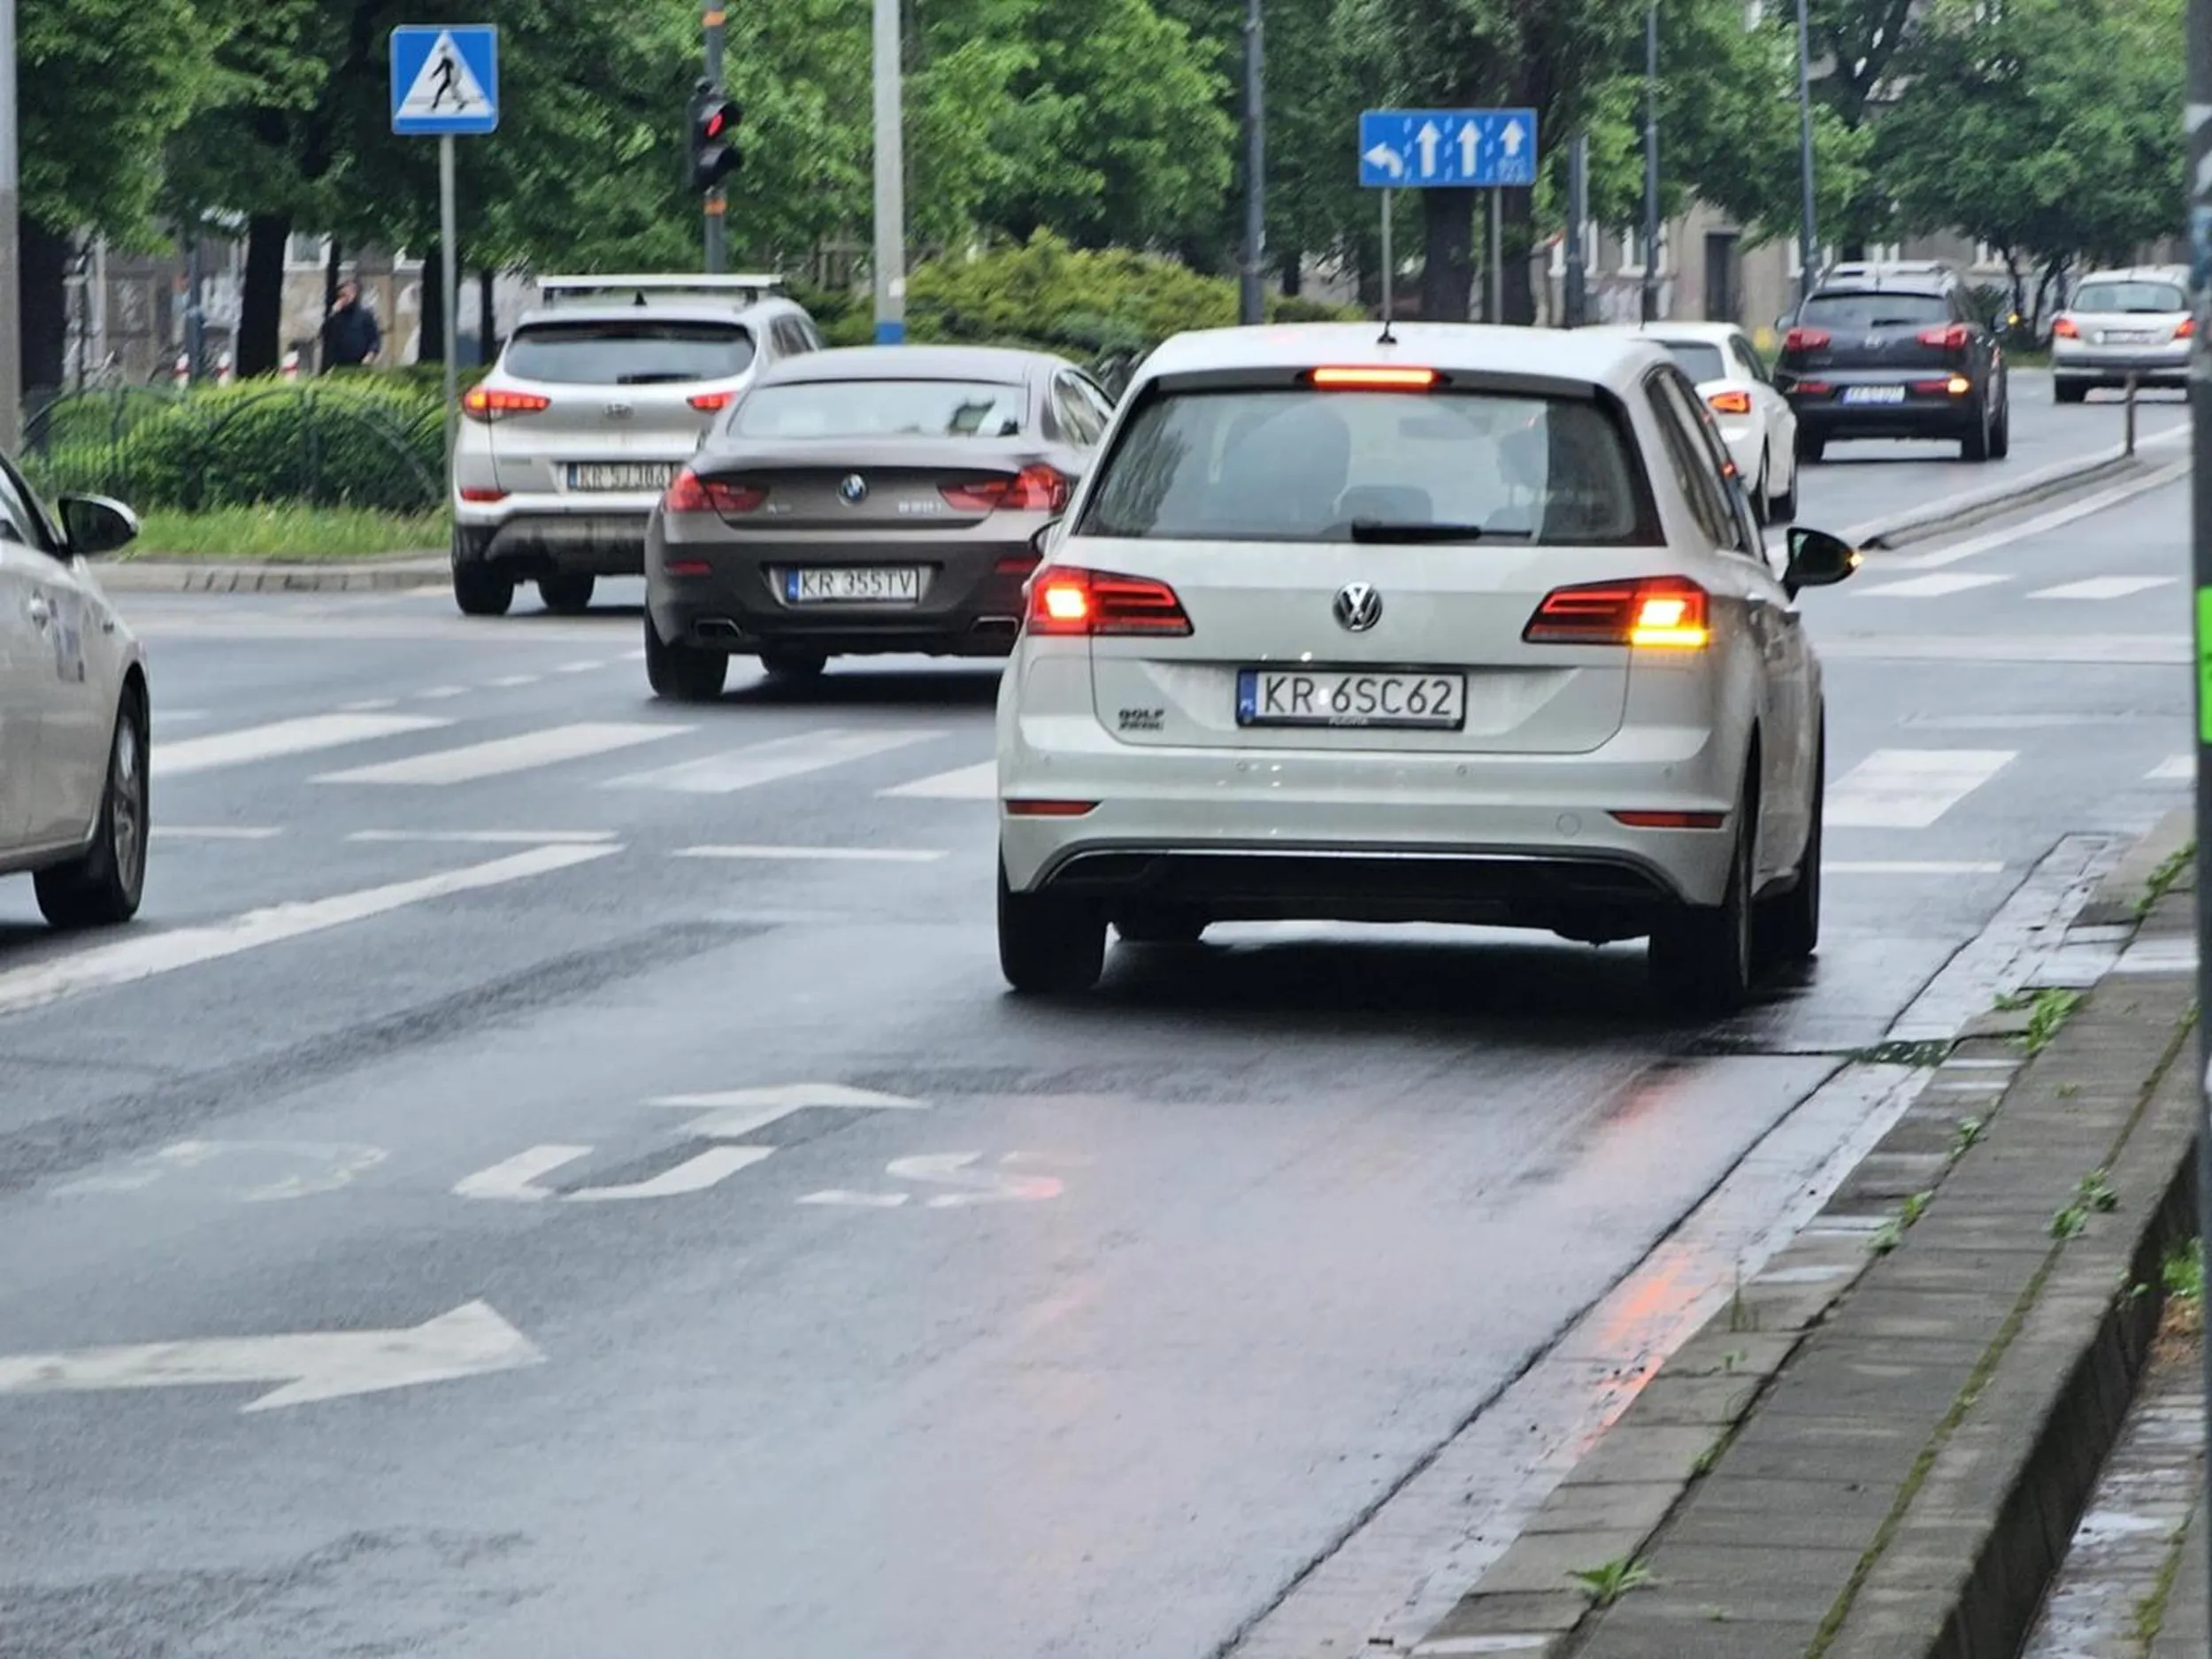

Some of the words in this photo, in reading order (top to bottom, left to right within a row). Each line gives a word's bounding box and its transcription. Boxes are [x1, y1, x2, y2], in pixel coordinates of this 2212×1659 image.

[802, 569, 833, 595] KR
[1264, 676, 1316, 713] KR
[1331, 677, 1452, 715] 6SC62
